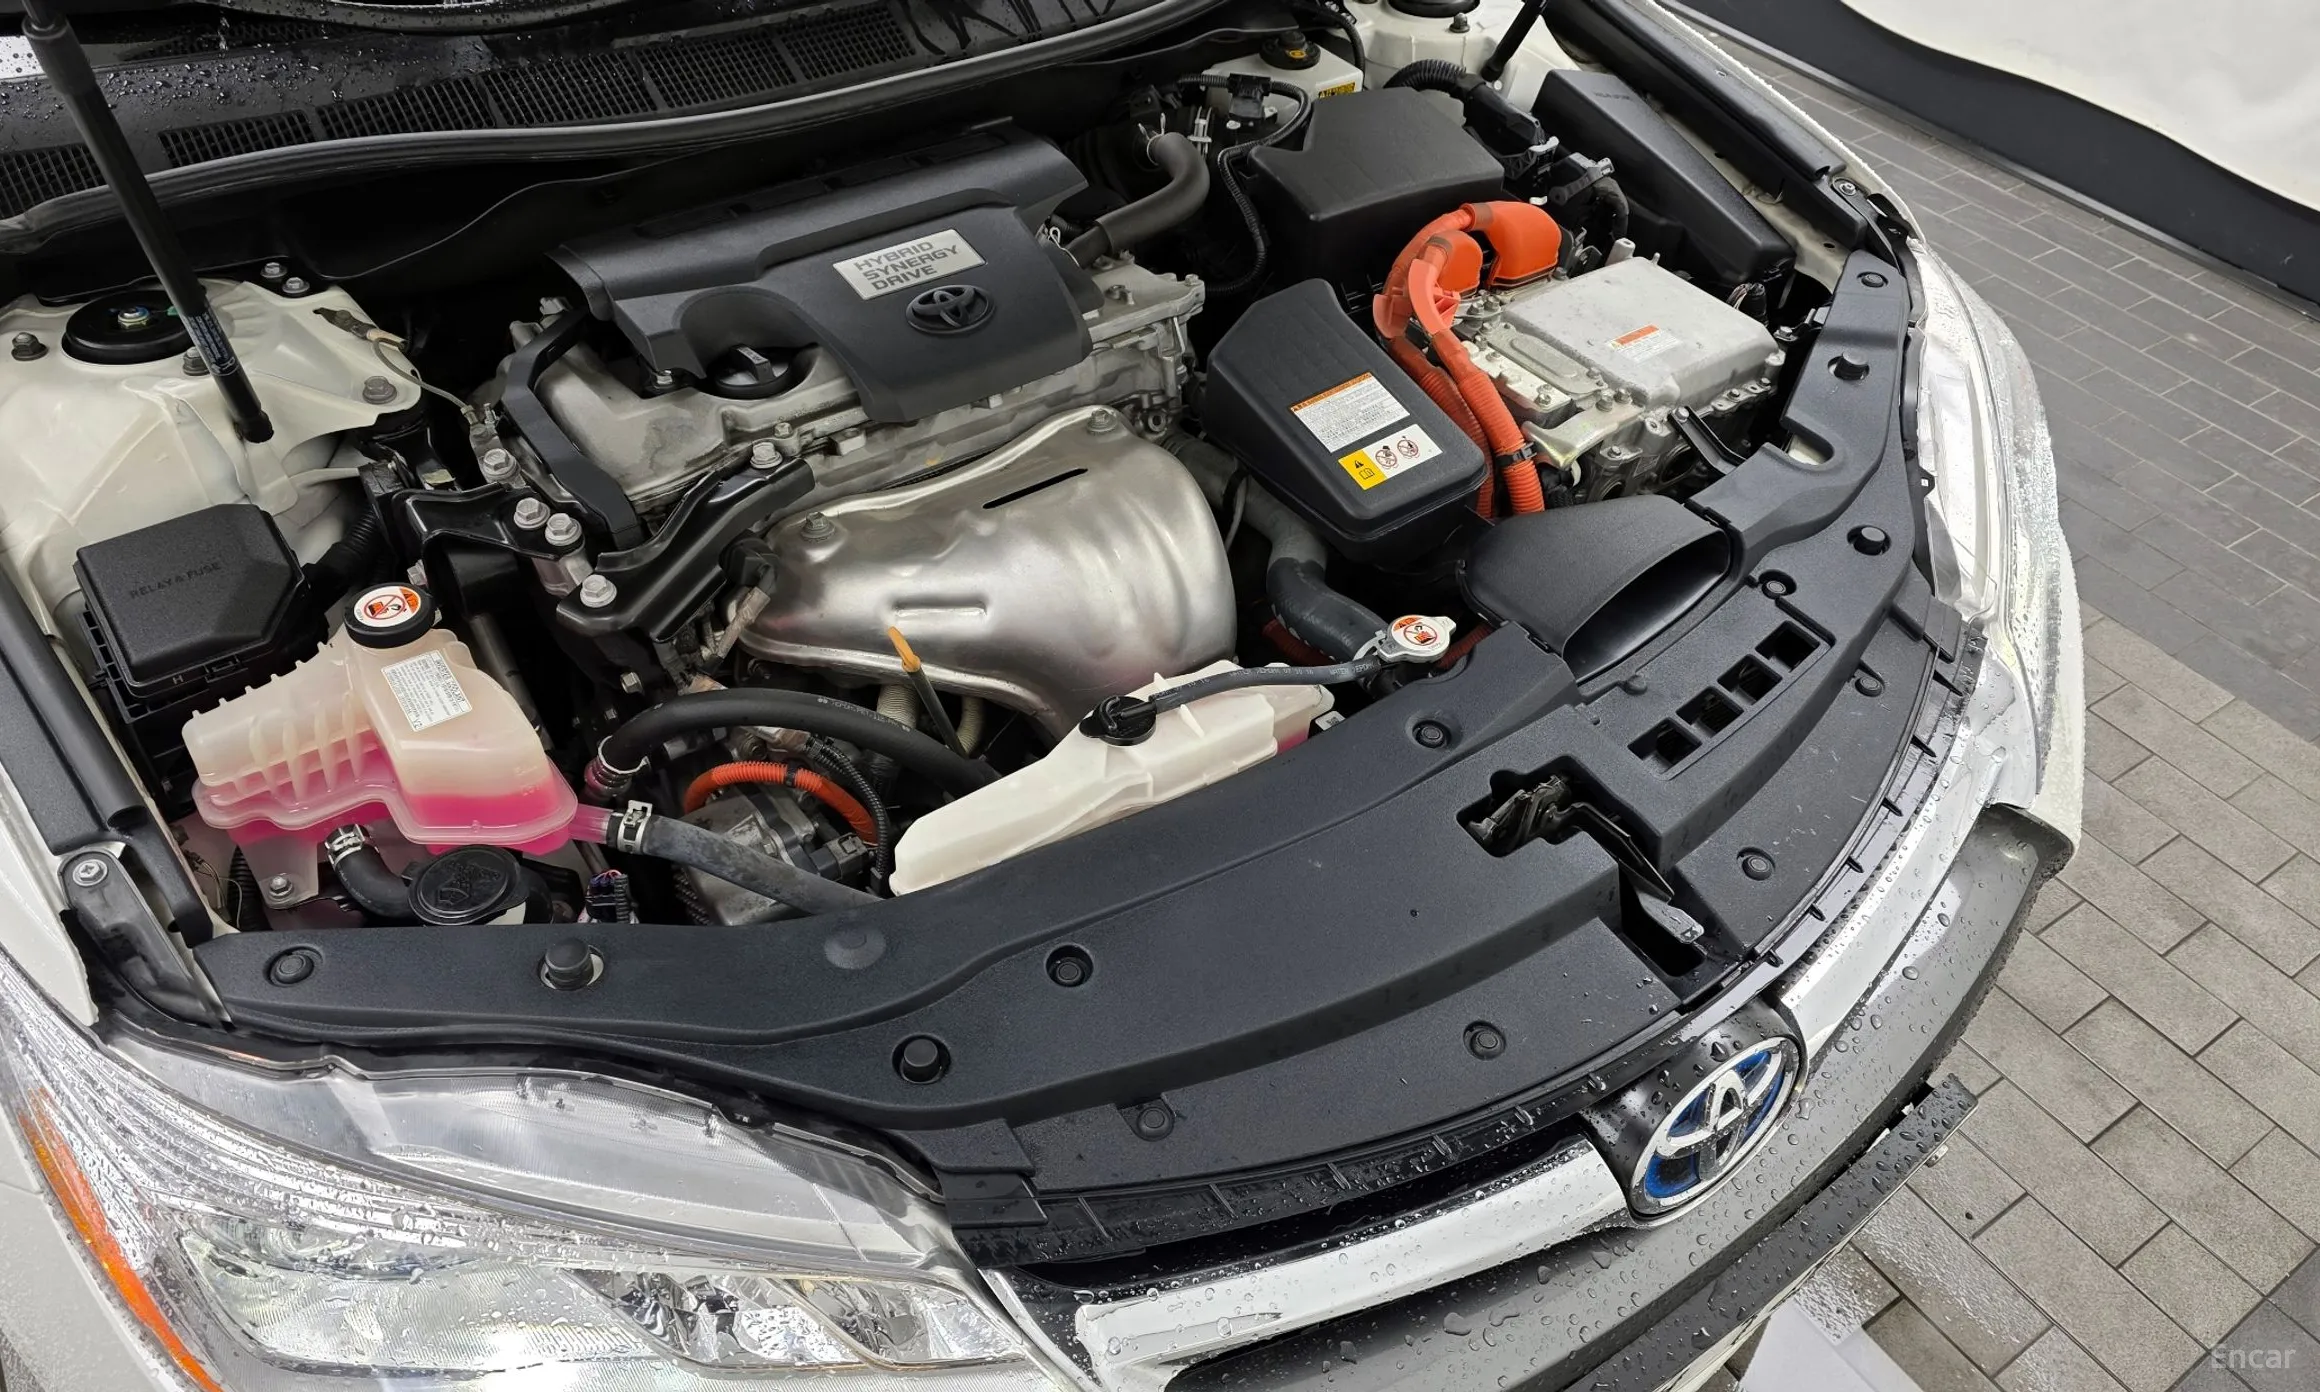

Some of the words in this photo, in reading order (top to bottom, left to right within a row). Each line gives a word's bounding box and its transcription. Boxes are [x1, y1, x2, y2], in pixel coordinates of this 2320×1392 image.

[853, 241, 934, 271] HYBRID
[862, 244, 958, 281] SYNERGY
[871, 265, 938, 291] DRIVE
[129, 578, 172, 600] RELAY
